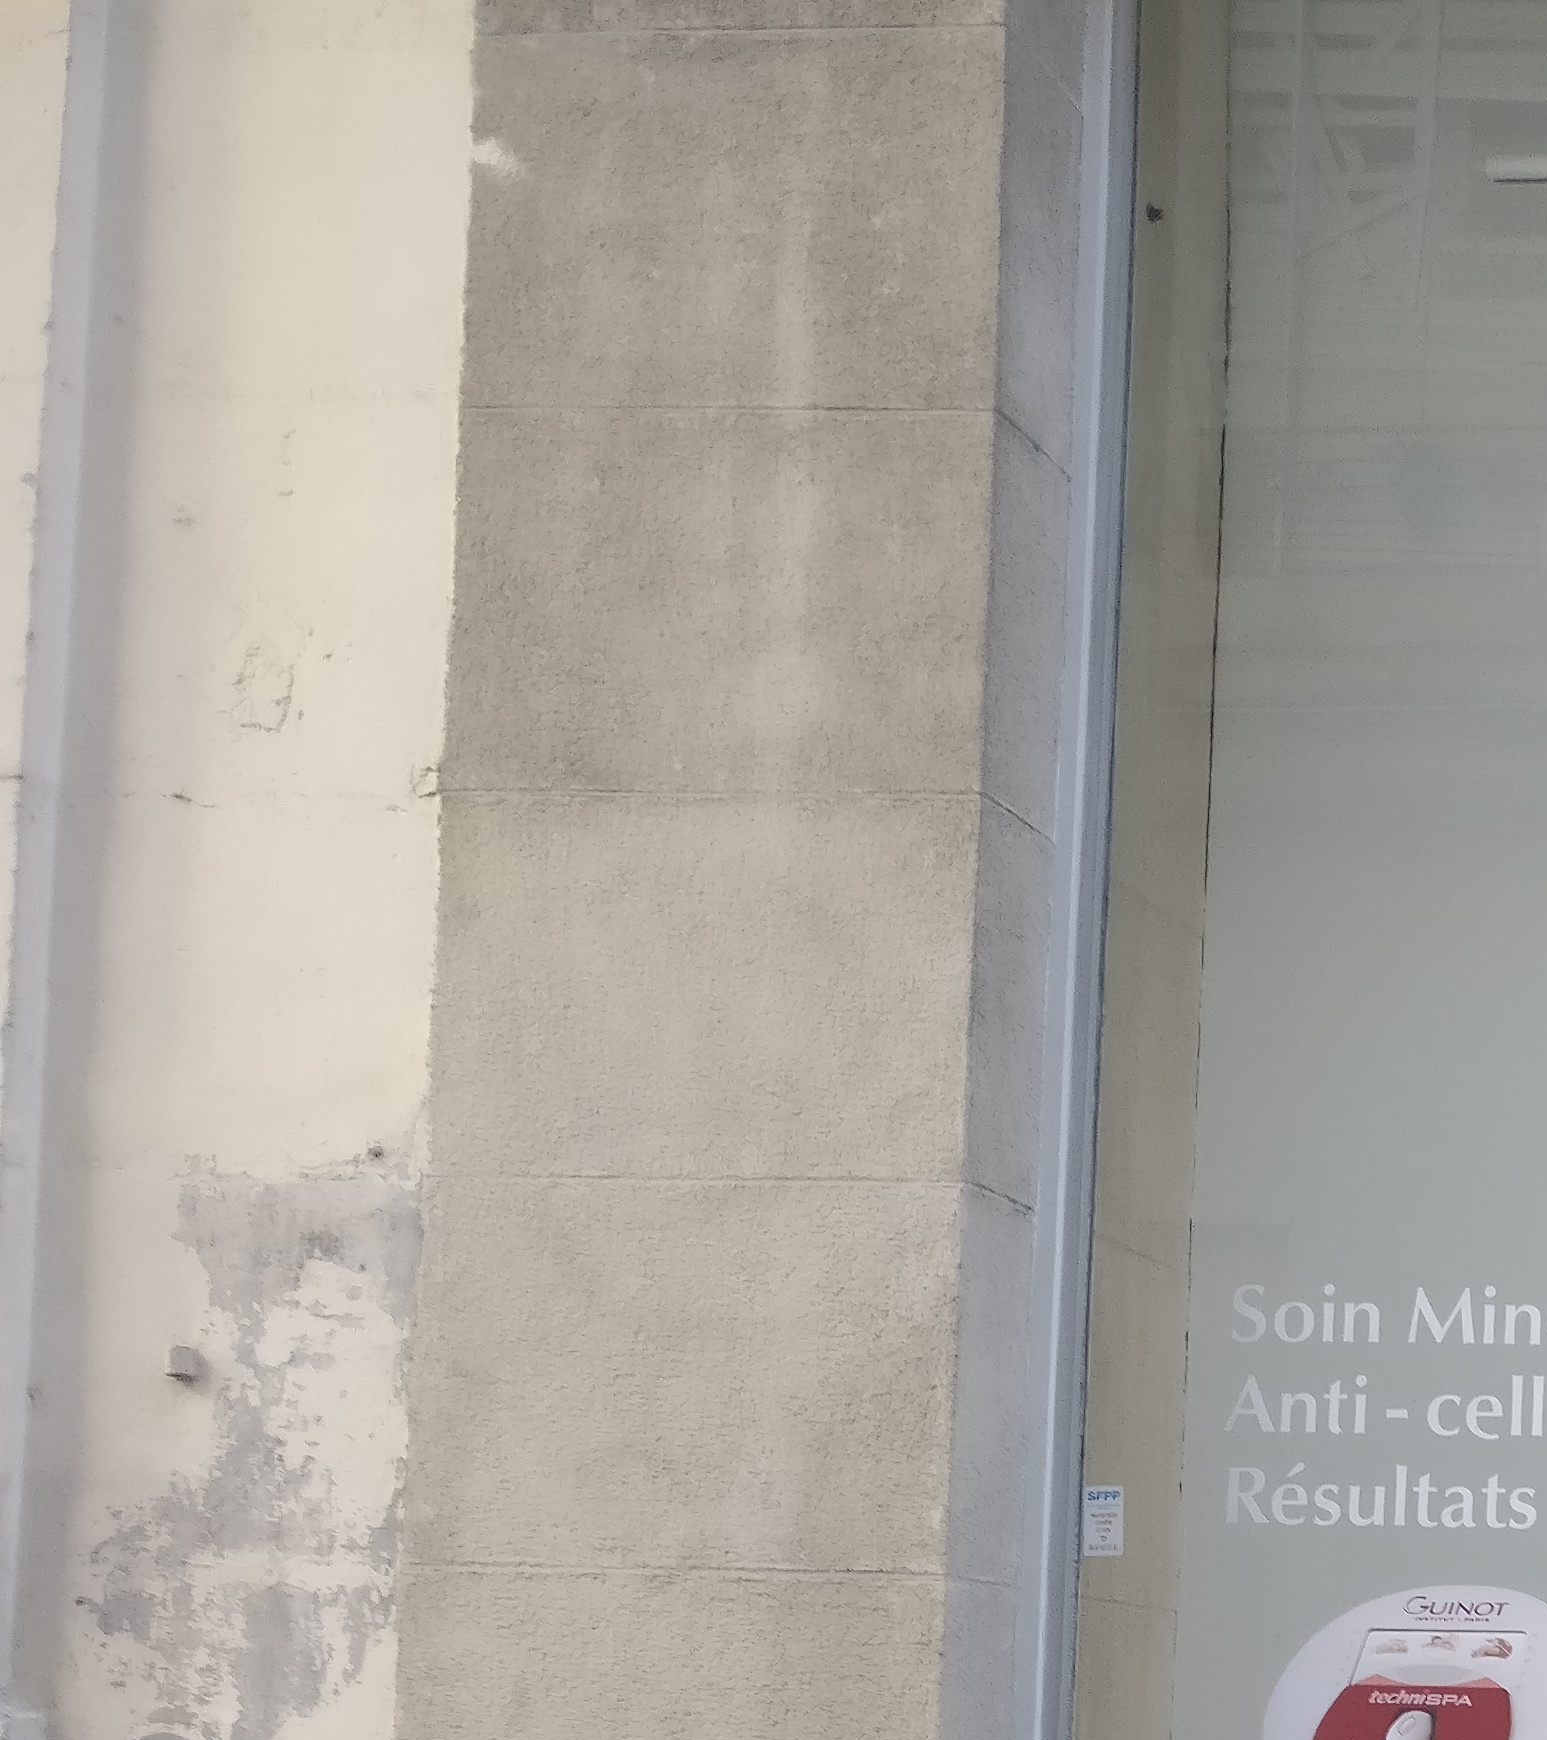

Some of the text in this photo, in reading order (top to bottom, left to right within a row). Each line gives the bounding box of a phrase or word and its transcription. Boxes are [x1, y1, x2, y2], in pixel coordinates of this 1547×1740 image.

[1231, 1283, 1381, 1347] Soin
[1224, 1461, 1538, 1531] Résultats
[1402, 1595, 1511, 1617] GUINOT
